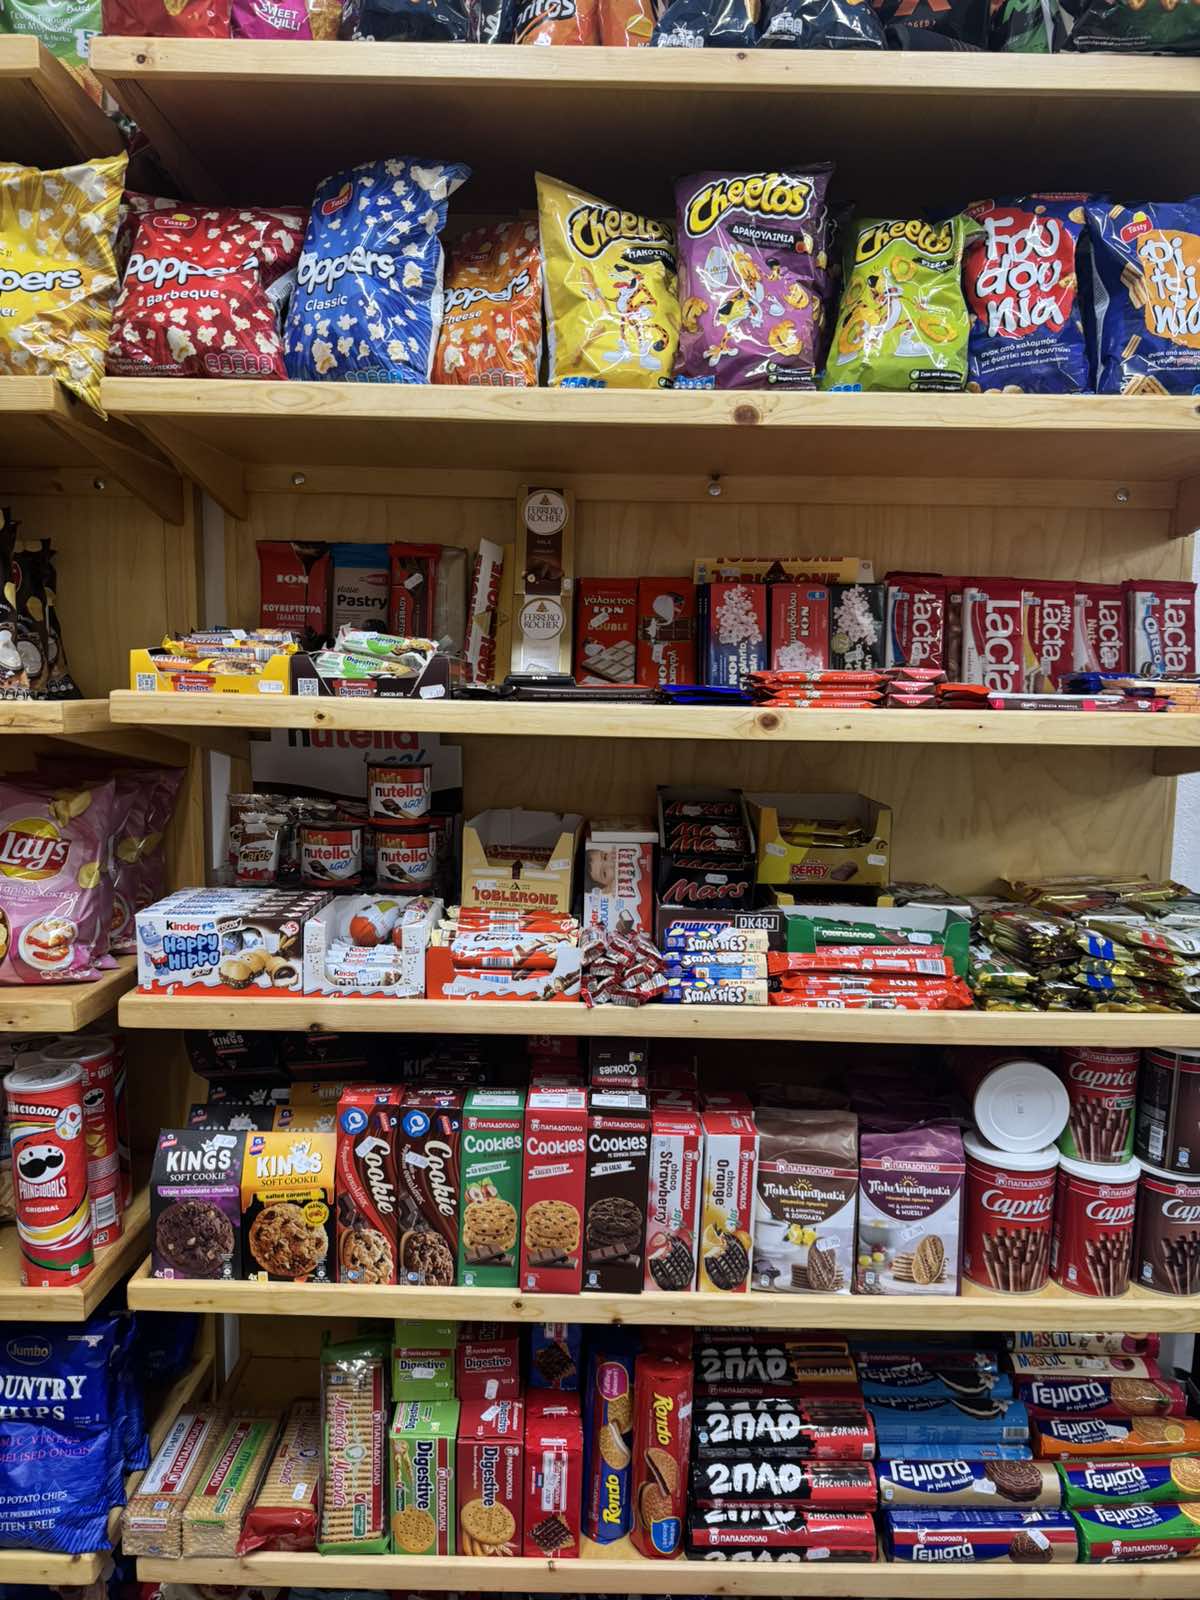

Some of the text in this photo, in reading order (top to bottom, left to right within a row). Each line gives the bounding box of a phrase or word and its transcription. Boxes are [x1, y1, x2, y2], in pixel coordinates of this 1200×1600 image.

[261, 2, 299, 19] SWEET
[269, 16, 301, 31] CHILLI
[688, 173, 812, 233] Cheetos
[163, 218, 189, 229] Tasty
[1127, 220, 1148, 235] Tasty
[732, 226, 795, 244] ΔΡΑΚΟΥΛΙΝΙΑ
[146, 288, 220, 307] Barbeque
[305, 295, 348, 312] Classic
[527, 505, 563, 515] FERRERO
[527, 513, 562, 522] ROCHER
[276, 574, 309, 585] ION
[336, 594, 388, 610] Pastry
[583, 595, 635, 607] γάλακτος
[523, 613, 560, 621] FERRERO
[523, 621, 559, 630] ROCHER
[587, 621, 629, 632] DOUBLE
[911, 593, 937, 661] Lacta
[1042, 599, 1066, 662] Lacta
[1098, 600, 1122, 664] Lacta
[1144, 615, 1162, 666] OREO
[1164, 598, 1192, 673] Lacta
[983, 599, 1021, 693] Lacta
[346, 654, 379, 667] Digestive
[375, 782, 425, 798] nutella
[304, 844, 350, 860] nutella
[381, 847, 428, 863] nutella
[791, 863, 829, 877] DERBY
[472, 886, 559, 906] TOBLERONE
[663, 879, 749, 902] Mars
[739, 916, 776, 930] DK48J
[163, 933, 220, 956] Happy
[167, 950, 221, 971] Hippo
[211, 1034, 245, 1048] KINGS
[598, 1063, 637, 1075] Cookies
[464, 1134, 522, 1154] Cookies
[526, 1137, 585, 1155] Cookies
[588, 1134, 648, 1152] Cookies
[166, 1149, 232, 1173] KINGS
[170, 1172, 227, 1182] SOFT COOKIE
[261, 1176, 319, 1187] SOFT COOKIE
[364, 1137, 396, 1215] Cookie
[424, 1140, 458, 1217] Cookie
[670, 1163, 680, 1191] choco
[712, 1159, 730, 1206] Orange
[726, 1170, 736, 1199] choco
[180, 1187, 210, 1195] chocolate
[265, 1190, 312, 1200] salted caramel
[654, 1151, 673, 1225] Strawberry
[25, 1204, 60, 1213] ORIGINAL
[901, 1209, 924, 1218] MUESLI
[11, 1343, 49, 1358] Jumbo
[464, 1356, 512, 1370] Digestive
[1031, 1377, 1106, 1408] Γεμιστά
[652, 1392, 674, 1446] Rondo
[415, 1441, 434, 1510] Digestive
[480, 1446, 499, 1508] Digestive
[889, 1458, 972, 1488] Γεμιστά
[1084, 1463, 1146, 1491] Γεμιστά
[7, 1490, 68, 1504] POTATO CHIPS
[602, 1473, 622, 1525] Rondo
[28, 1518, 56, 1530] FREE
[912, 1537, 975, 1562] Γεμιστά
